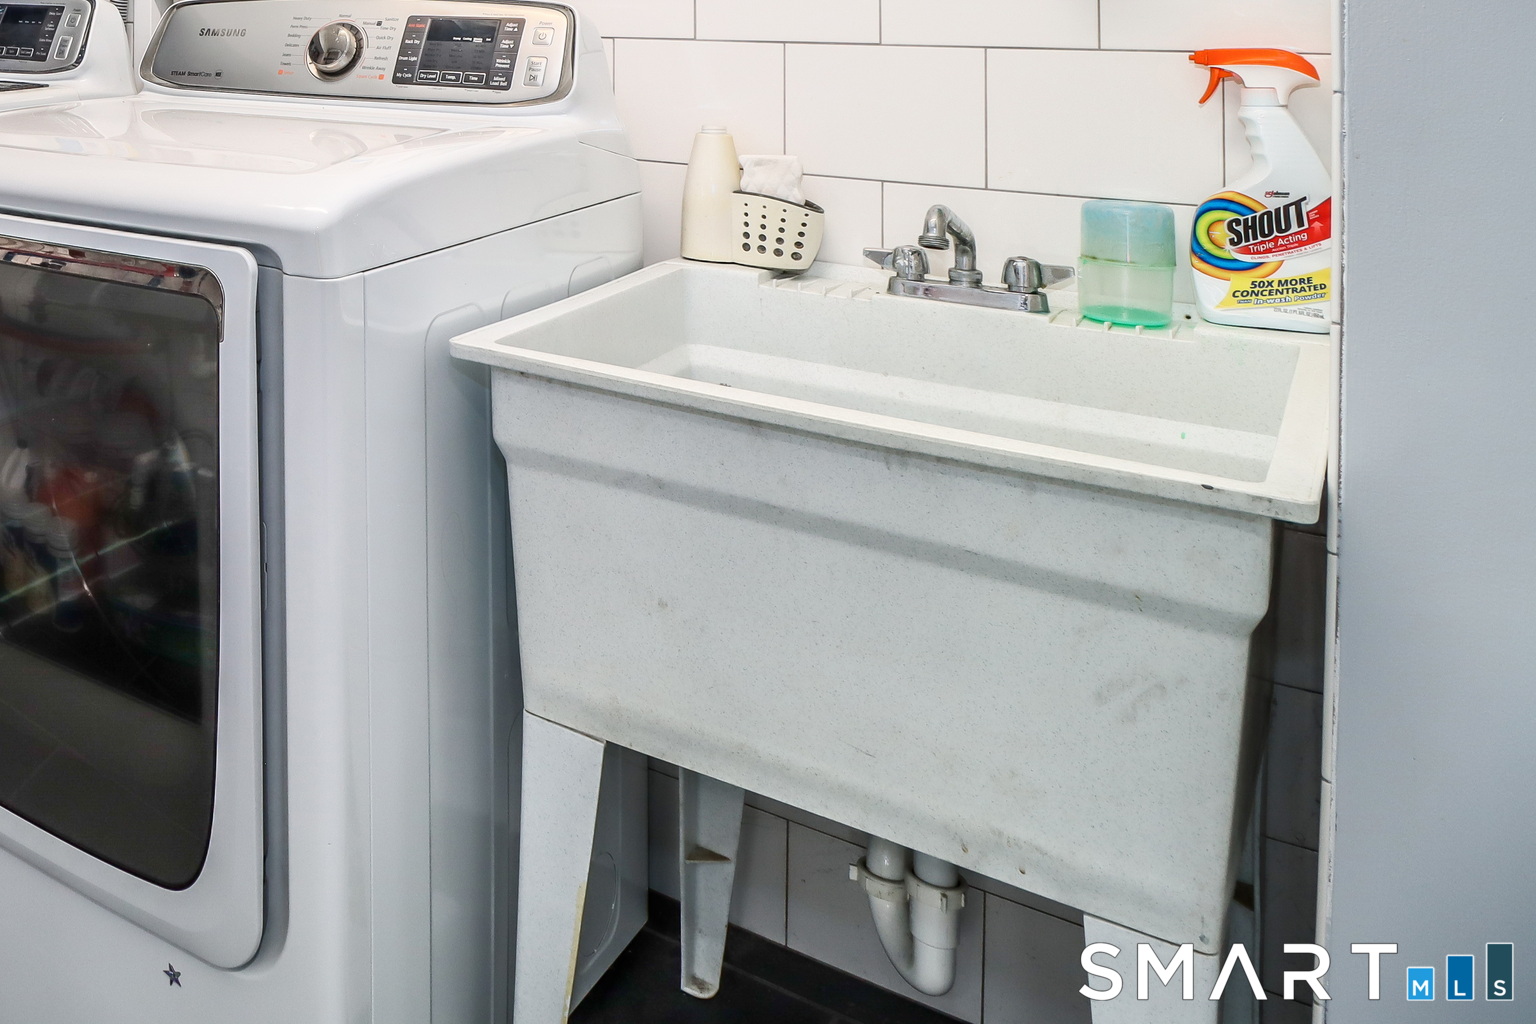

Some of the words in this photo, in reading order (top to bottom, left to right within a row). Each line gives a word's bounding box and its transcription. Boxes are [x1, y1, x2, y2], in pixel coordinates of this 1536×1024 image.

[198, 27, 247, 37] SAMSUNG
[1227, 196, 1307, 247] SHOUT
[1249, 240, 1274, 253] Triple
[1278, 232, 1308, 246] Acting
[1272, 249, 1303, 257] PENETRATES
[1250, 280, 1274, 289] 50X
[1278, 277, 1313, 287] MORE
[1232, 284, 1327, 298] CONCENTRATED
[1253, 296, 1292, 305] In-wash
[1294, 292, 1326, 302] Powder
